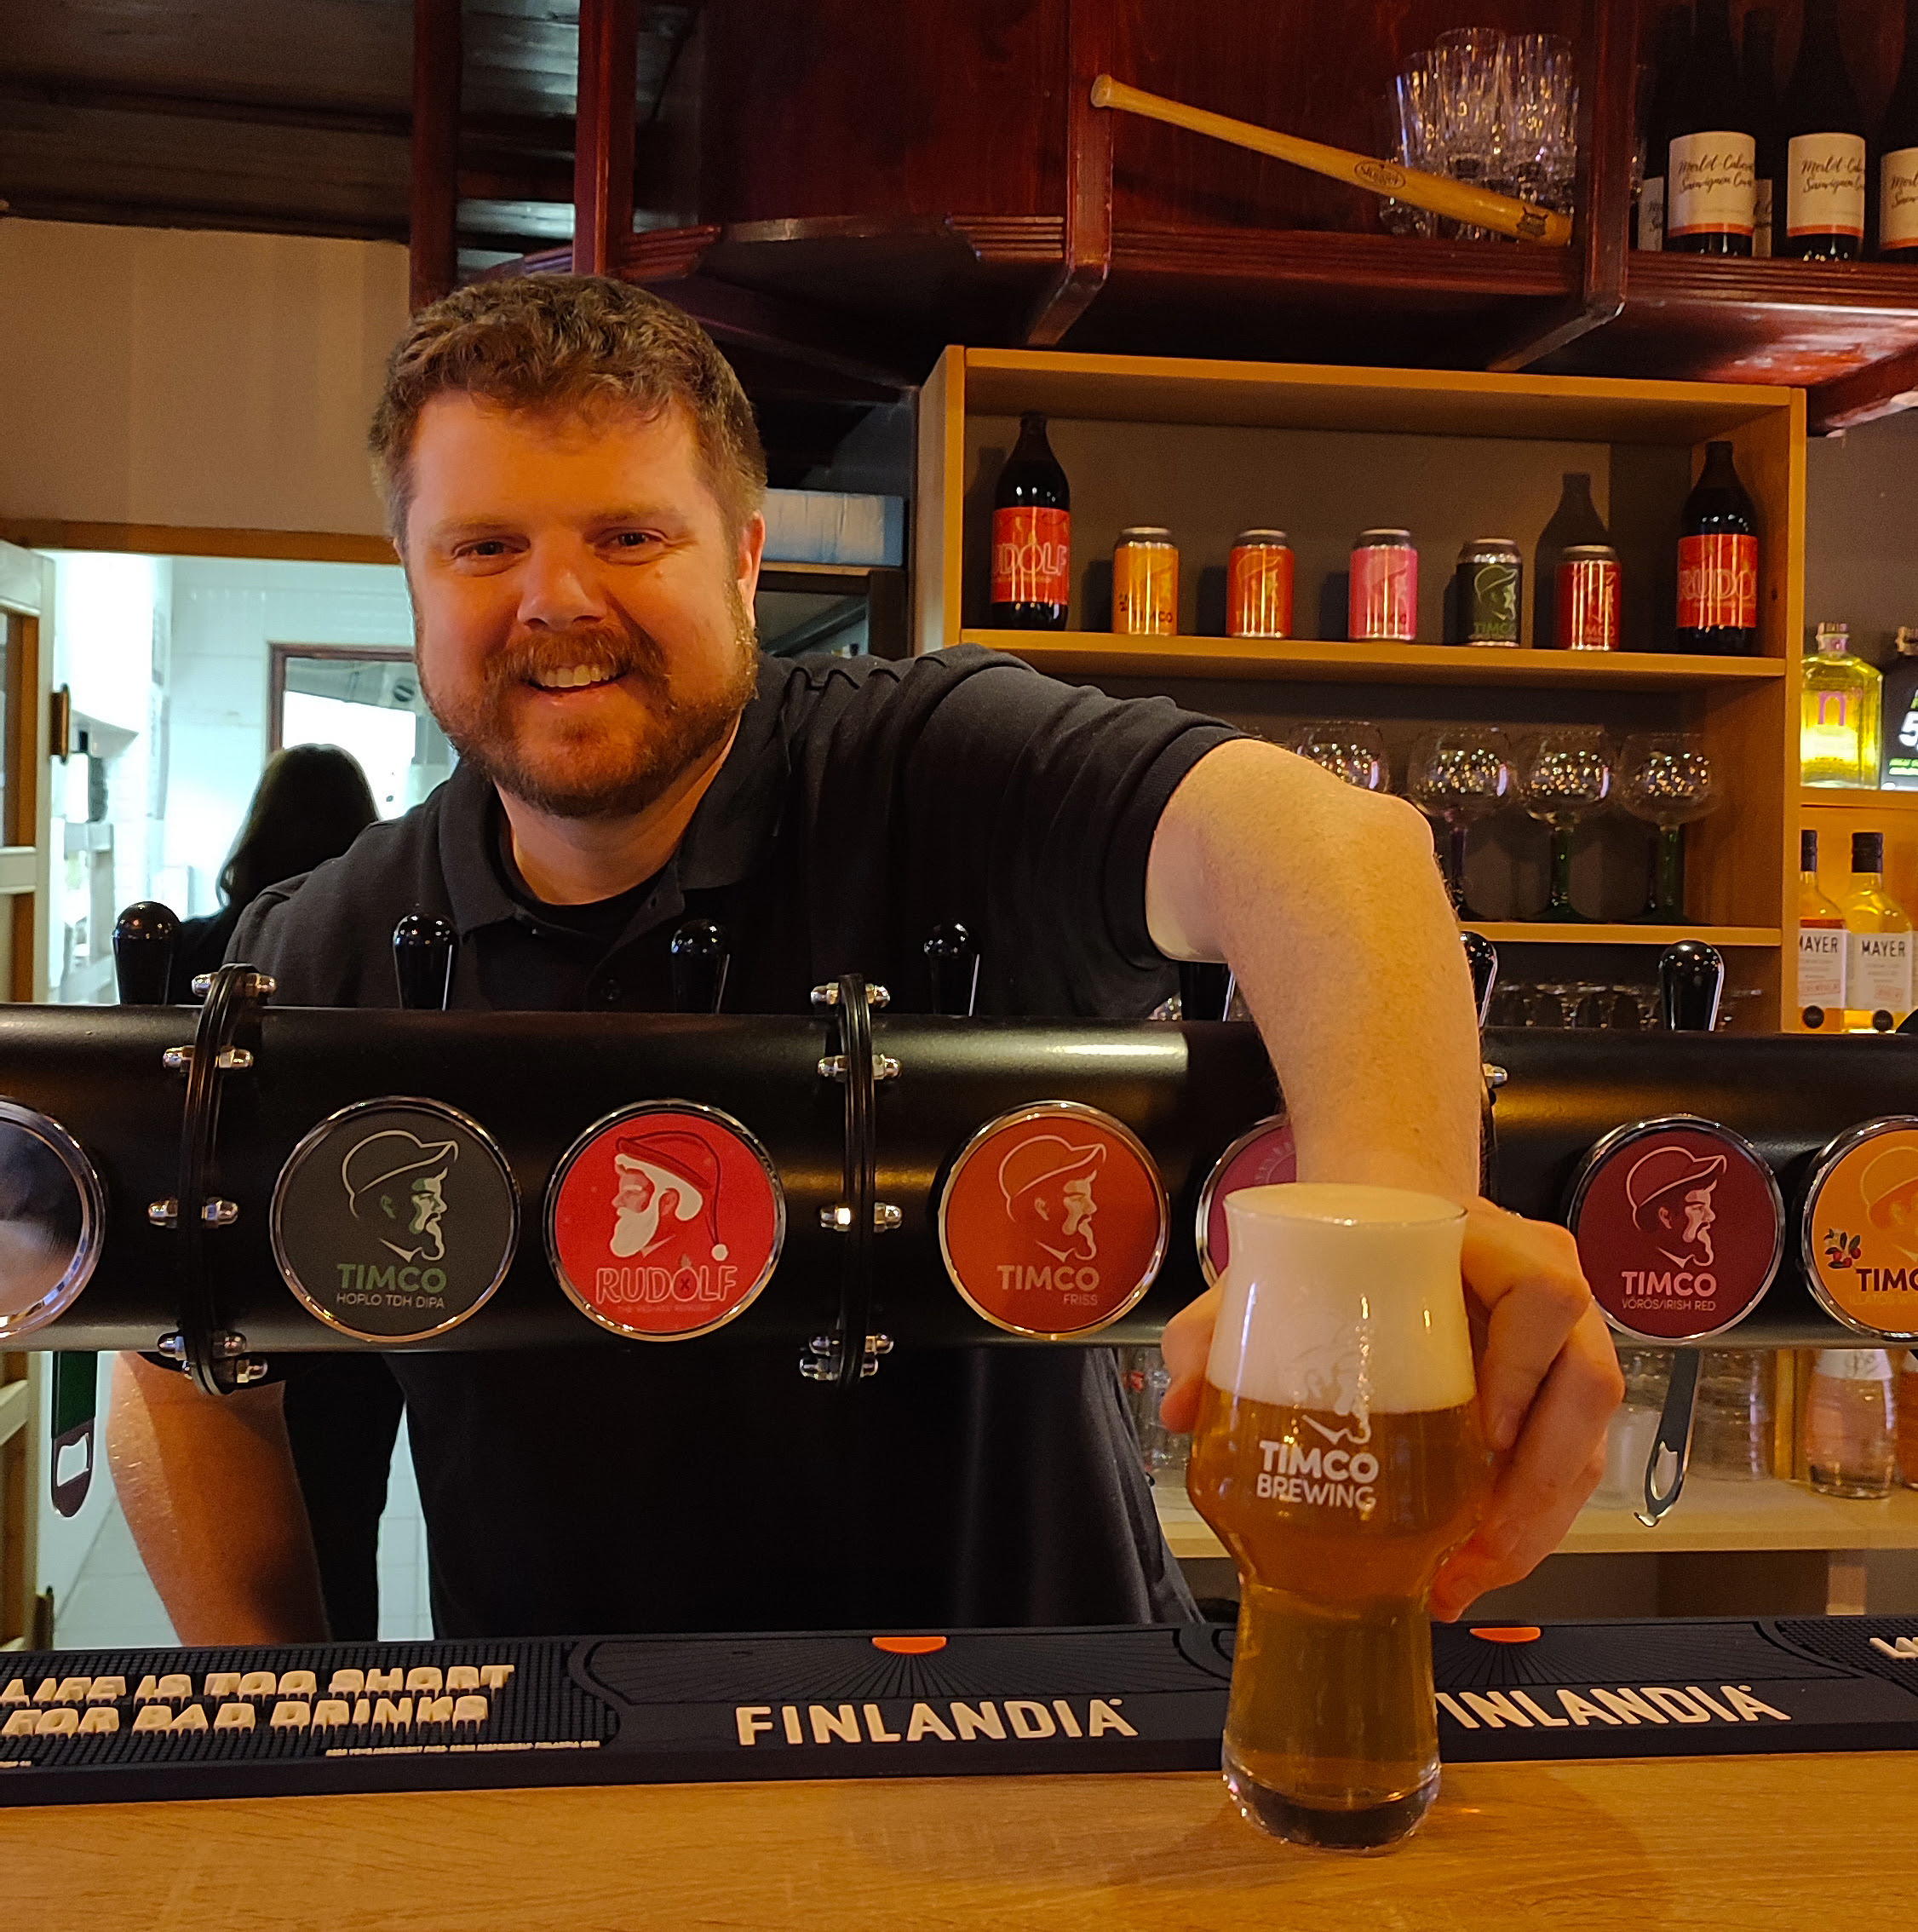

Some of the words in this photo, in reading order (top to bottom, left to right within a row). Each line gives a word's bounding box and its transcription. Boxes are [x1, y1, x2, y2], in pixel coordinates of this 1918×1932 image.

[1861, 940, 1906, 957] MAYER
[336, 1263, 447, 1294] TIMCO
[596, 1265, 738, 1304] RUDOLF
[996, 1264, 1100, 1292] TIMCO
[1621, 1271, 1717, 1297] TIMCO
[386, 1294, 412, 1307] TDH
[1063, 1293, 1099, 1307] FRISS
[1694, 1300, 1717, 1312] RED
[1259, 1440, 1380, 1484] TIMCO
[1256, 1472, 1377, 1512] BREWING
[0, 1675, 127, 1706] LIFE
[134, 1674, 193, 1708] IS
[204, 1670, 317, 1705] TOO
[328, 1664, 515, 1701] SHORT
[0, 1706, 120, 1738] FOR
[131, 1703, 256, 1737] BAD
[269, 1695, 489, 1736] DRINKS
[735, 1698, 1139, 1746] FINLANDIA
[1434, 1684, 1791, 1729] INLANDIA
